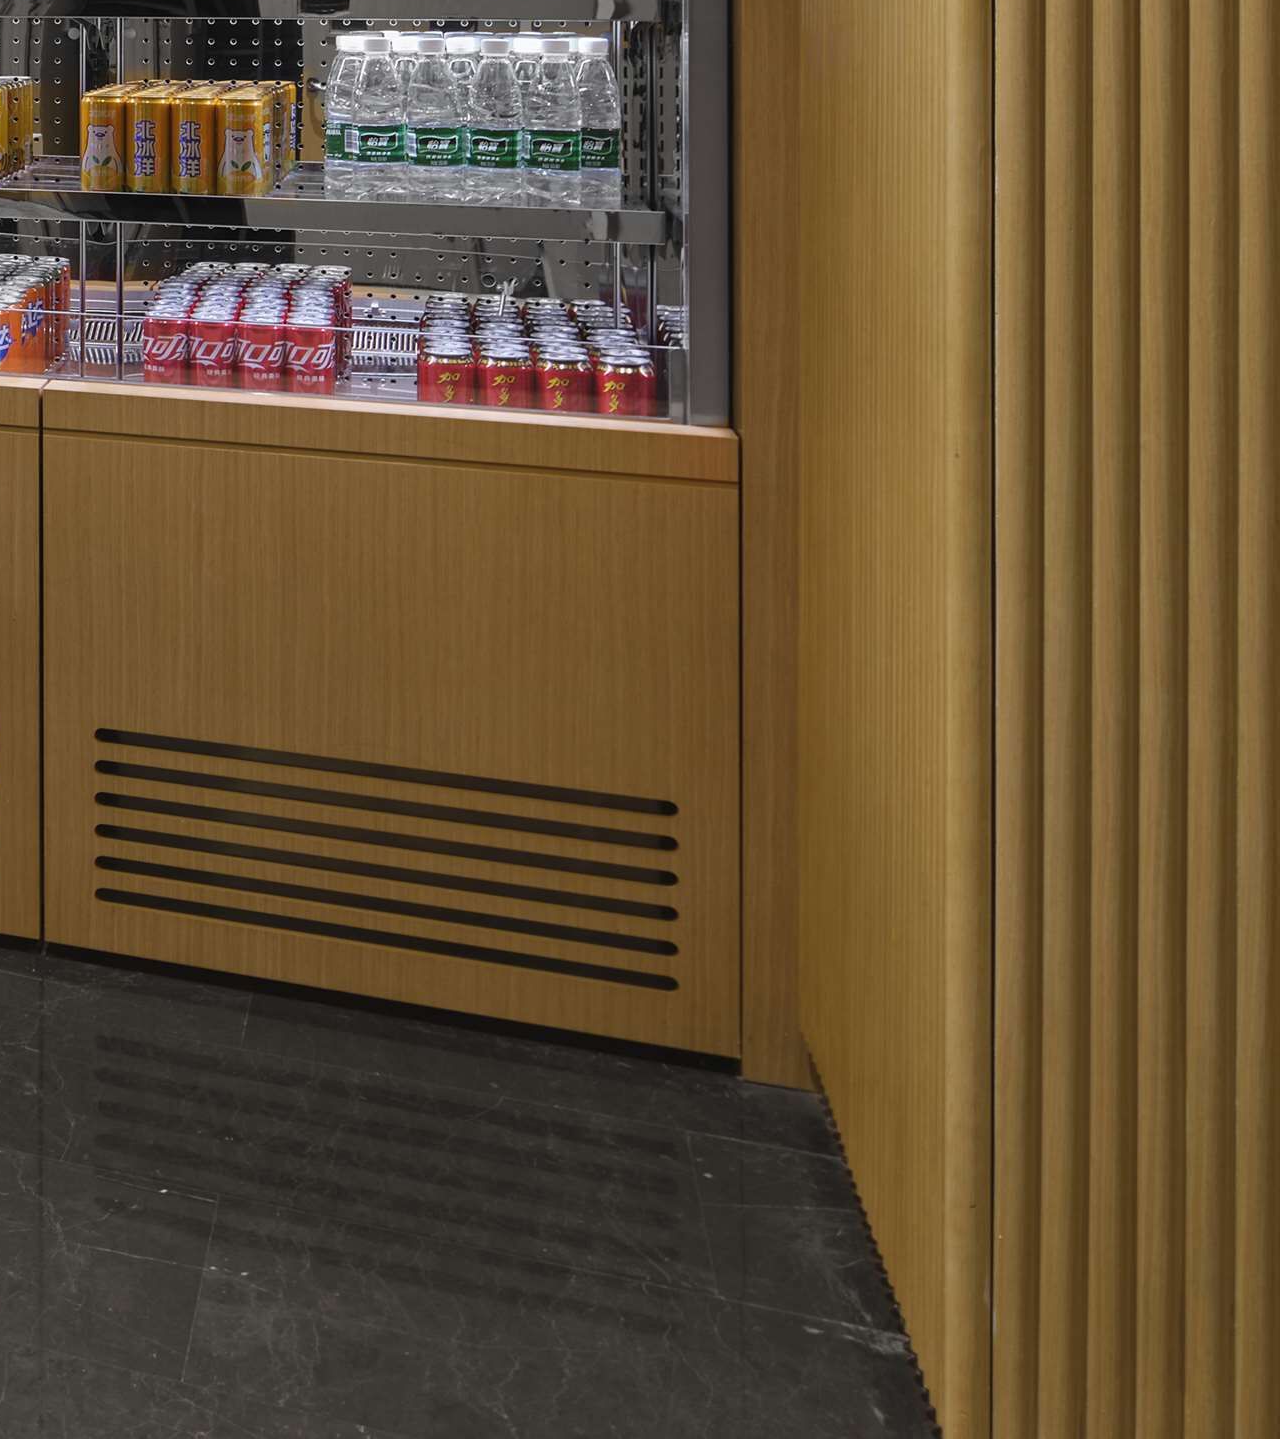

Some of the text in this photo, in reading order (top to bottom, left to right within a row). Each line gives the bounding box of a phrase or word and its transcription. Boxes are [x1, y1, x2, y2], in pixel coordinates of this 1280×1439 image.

[134, 120, 157, 177] 北冰洋
[179, 120, 201, 177] 北冰洋
